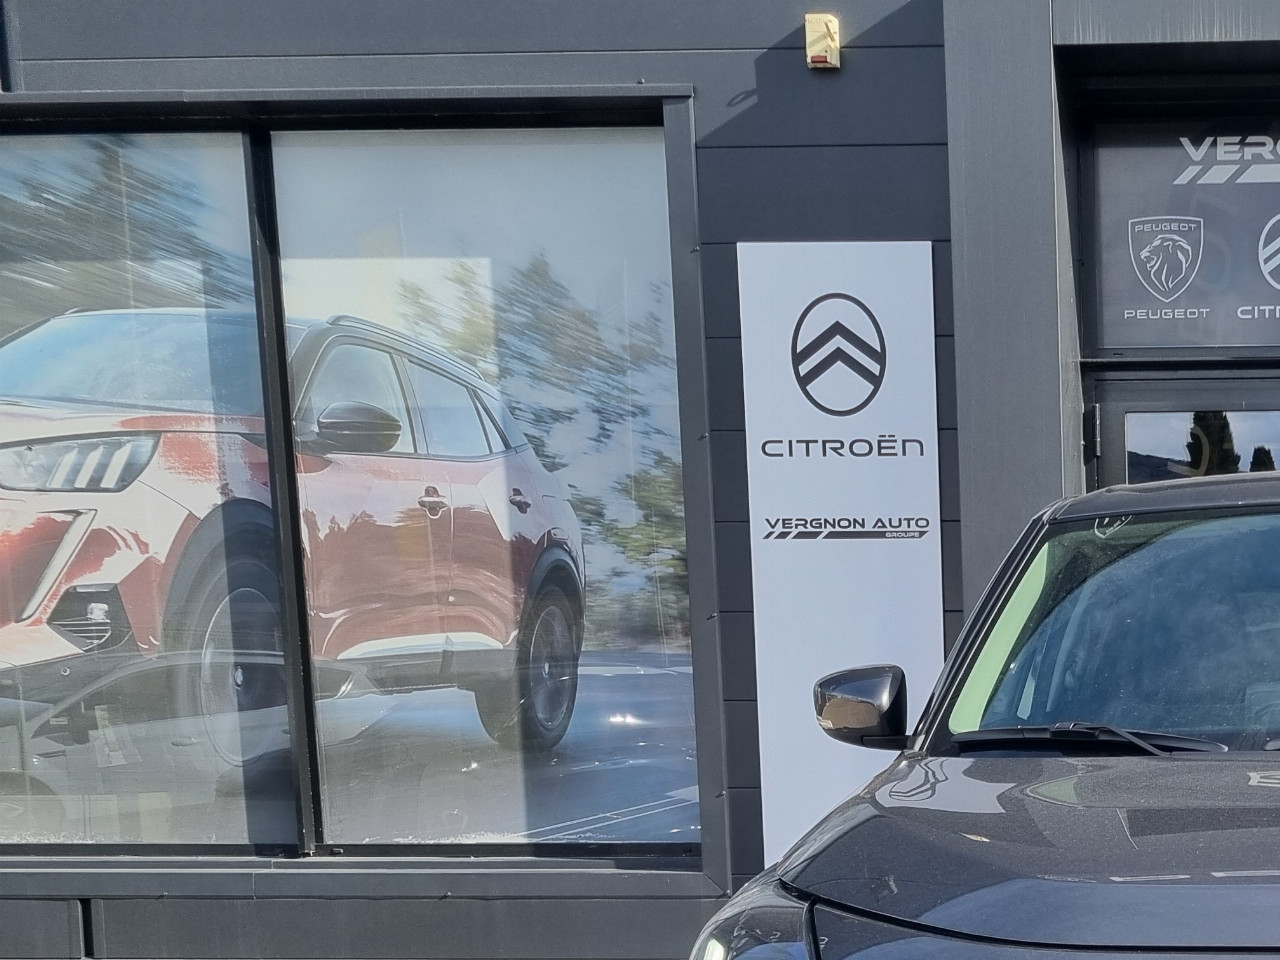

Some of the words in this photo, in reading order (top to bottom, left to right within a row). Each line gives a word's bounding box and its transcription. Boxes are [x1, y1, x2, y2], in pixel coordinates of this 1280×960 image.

[1134, 222, 1197, 233] PEUGEOT
[1124, 308, 1210, 319] PEUGEOT
[765, 518, 865, 530] VERGNON
[872, 517, 930, 529] AUTO
